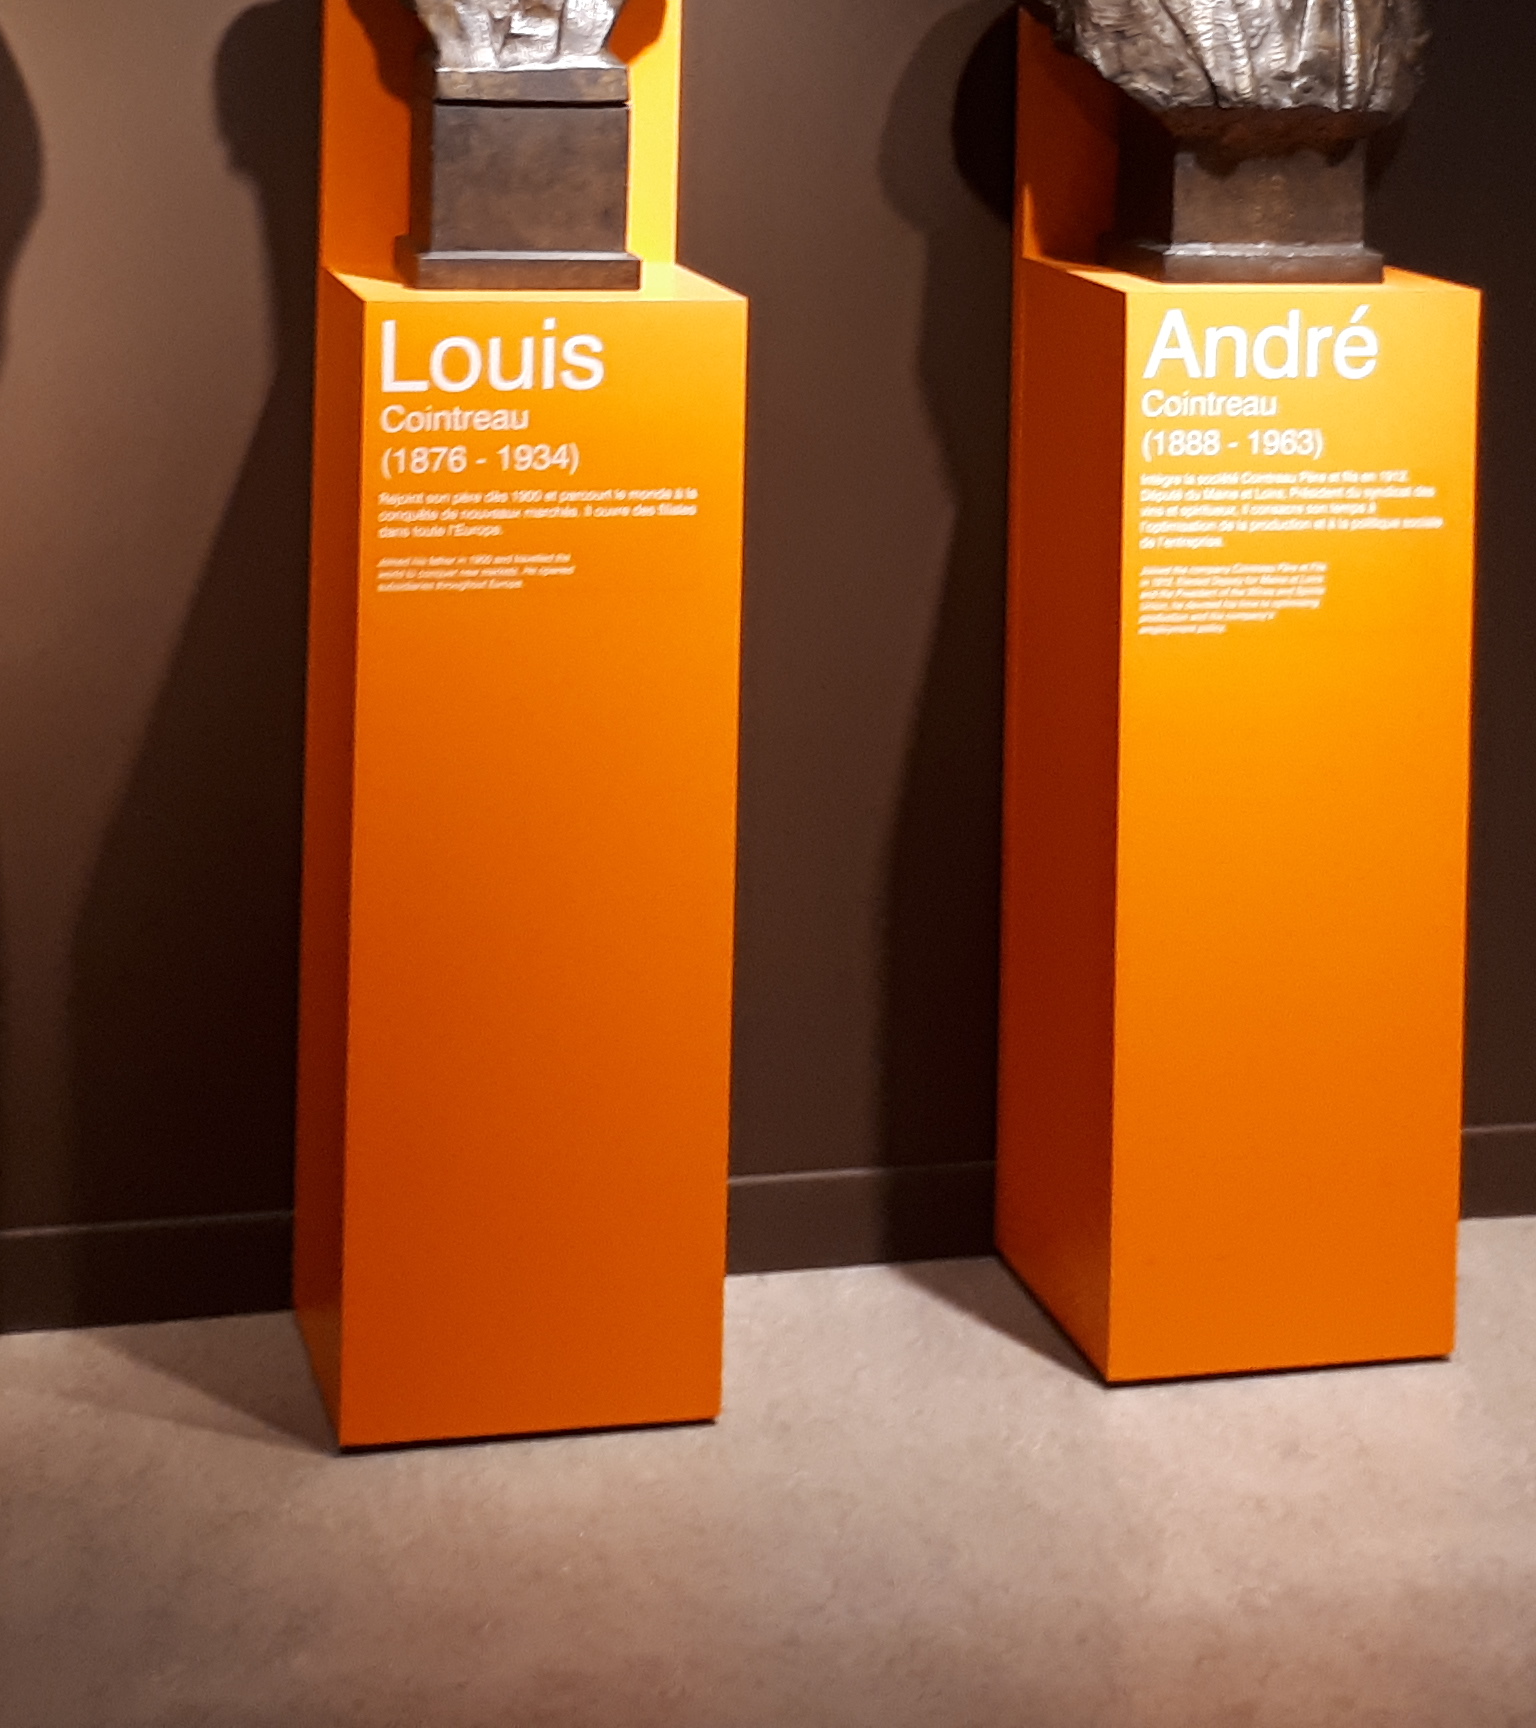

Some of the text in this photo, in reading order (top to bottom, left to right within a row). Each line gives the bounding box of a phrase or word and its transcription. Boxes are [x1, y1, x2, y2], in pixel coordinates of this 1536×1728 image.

[382, 317, 605, 392] Louis
[1143, 304, 1379, 379] André
[381, 405, 529, 433] Cointreau
[1142, 389, 1278, 417] Cointreau
[381, 446, 467, 480] (1876
[499, 443, 580, 475] 1934)
[1142, 429, 1222, 461] (1888
[1248, 429, 1324, 459] 1963)
